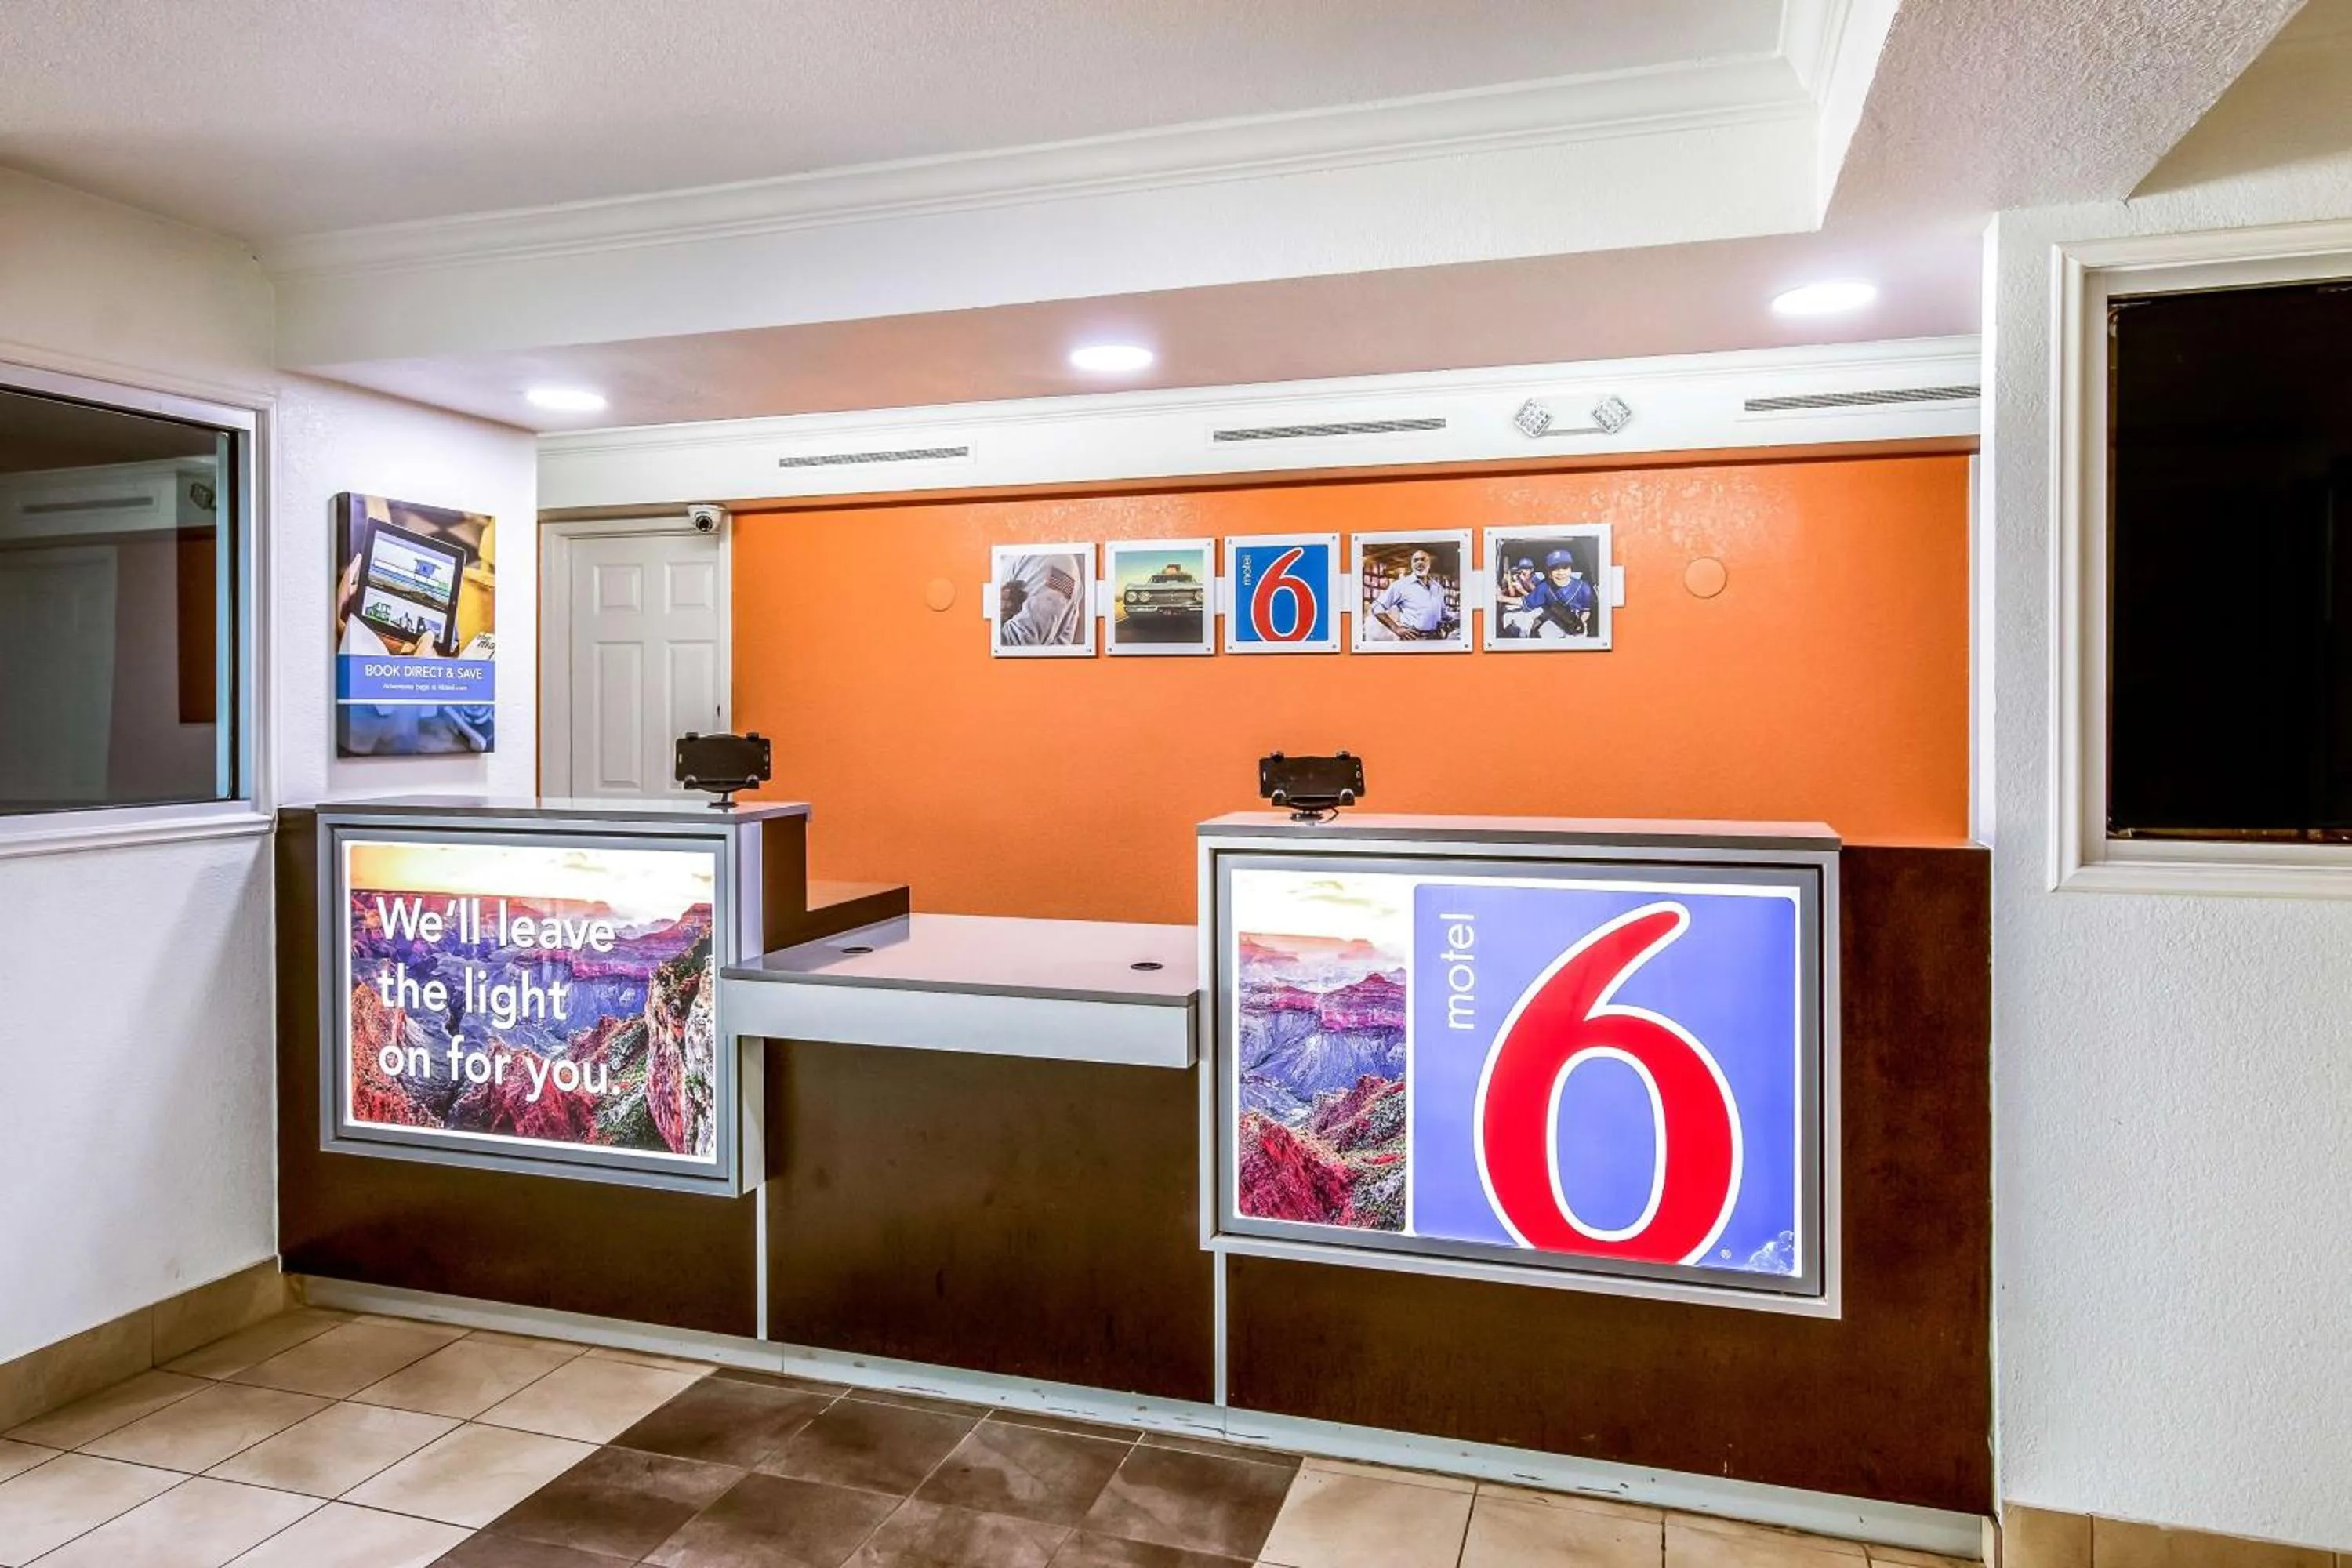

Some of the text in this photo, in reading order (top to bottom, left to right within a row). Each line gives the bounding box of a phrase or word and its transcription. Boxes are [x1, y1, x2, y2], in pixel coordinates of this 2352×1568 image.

[1242, 546, 1317, 641] motel 6
[365, 664, 482, 680] BOOK DIRECT & SAVE
[376, 896, 615, 952] We'll leave
[378, 963, 568, 1029] the light
[378, 1044, 430, 1078] on
[447, 1035, 511, 1085] for
[1439, 901, 1744, 1265] motel 6
